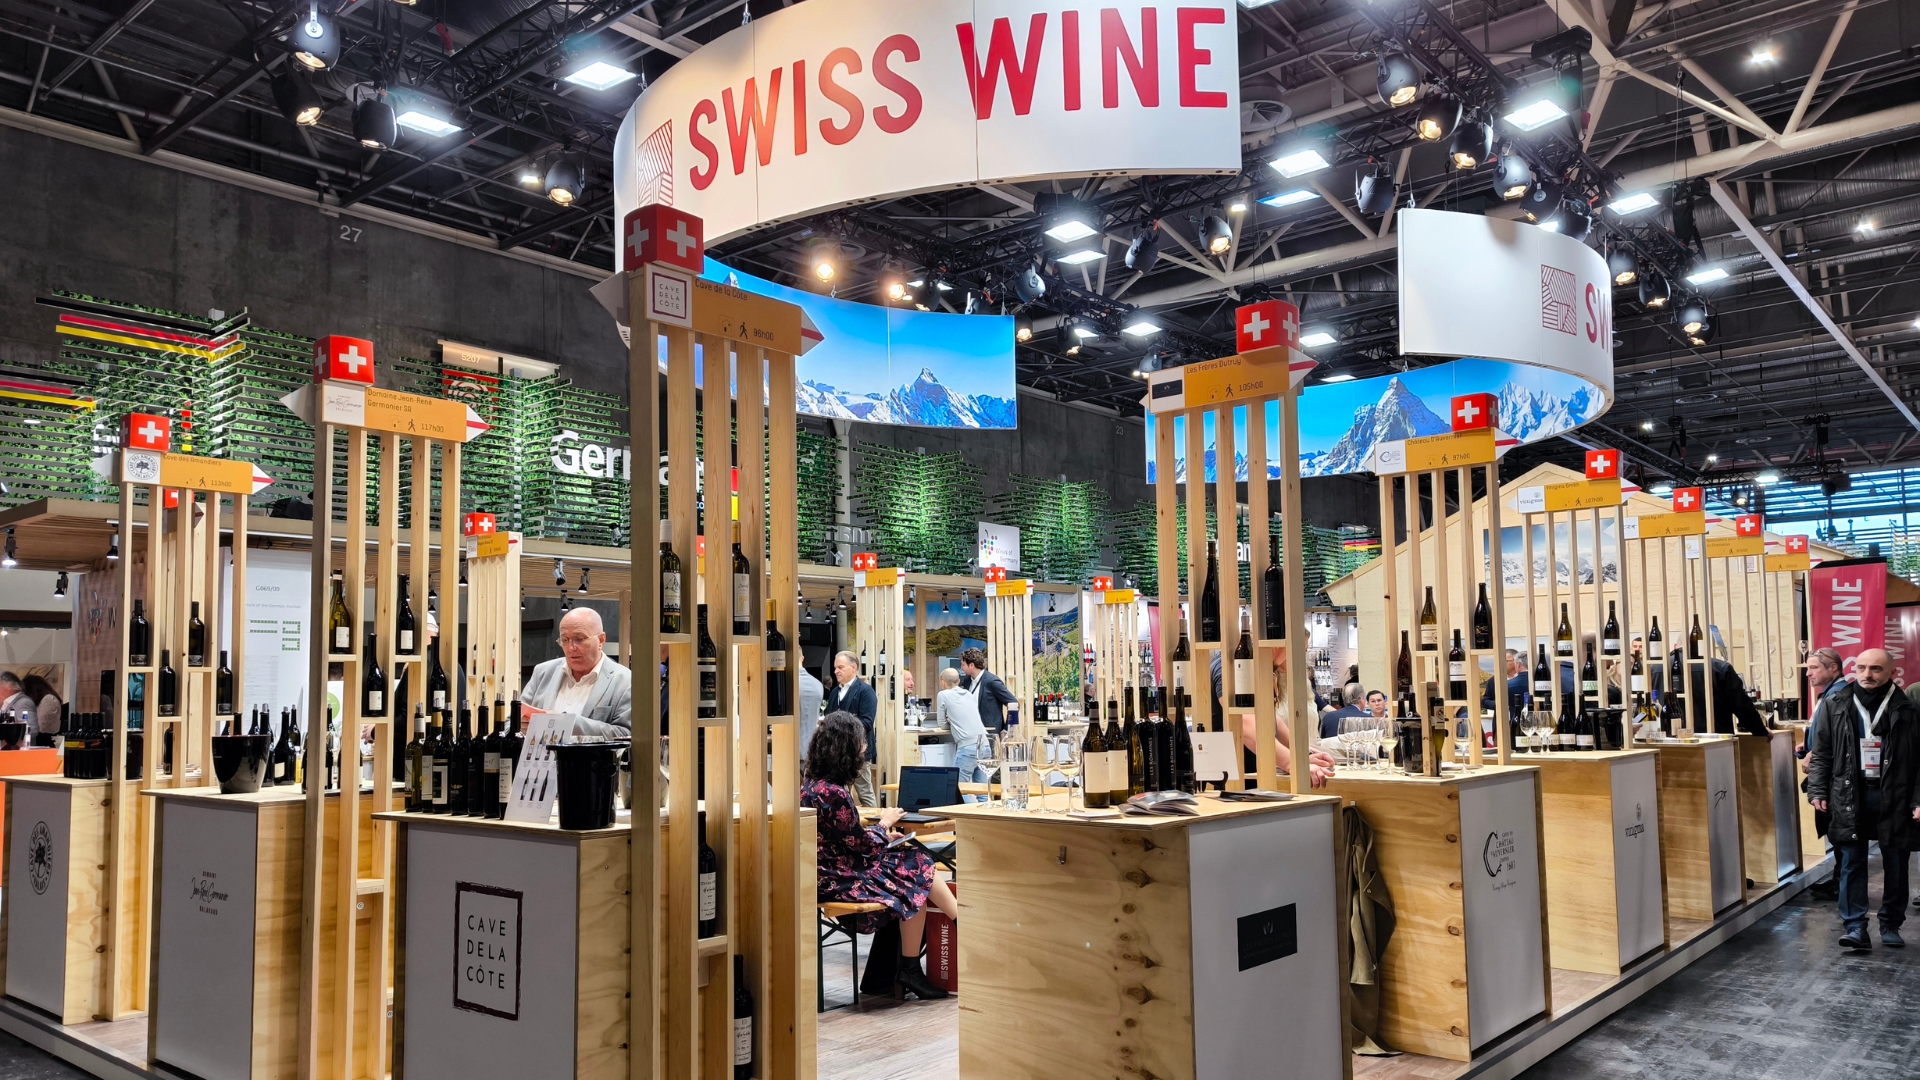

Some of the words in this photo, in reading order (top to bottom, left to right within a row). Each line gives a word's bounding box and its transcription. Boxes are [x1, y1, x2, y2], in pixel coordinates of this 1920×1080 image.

[689, 34, 923, 191] SWISS
[956, 6, 1229, 121] WINE
[340, 224, 363, 243] 27
[659, 283, 680, 294] CAVE
[695, 278, 713, 292] Cave
[714, 281, 724, 294] de
[724, 284, 731, 295] la
[732, 286, 748, 301] Côte
[659, 298, 680, 310] CÔTE
[753, 328, 774, 341] 96h00
[461, 353, 481, 364] 5207
[1186, 365, 1198, 374] Les
[1198, 362, 1218, 373] Frères
[1219, 358, 1242, 369] Dutruy
[1238, 381, 1264, 392] 105h00
[367, 389, 398, 400] Domaine
[398, 393, 433, 406] Jean-René
[367, 399, 402, 411] Germanier
[421, 423, 445, 433] 117h00
[1407, 438, 1430, 446] Château
[178, 455, 189, 463] des
[190, 457, 222, 467] Amandiers
[1452, 452, 1471, 461] 97h00
[211, 479, 232, 488] 113h00
[1832, 578, 1862, 648] WINE
[467, 914, 506, 937] CAVE
[941, 923, 949, 945] WINE
[941, 945, 949, 971] SWISS
[466, 963, 505, 989] CÔTE
